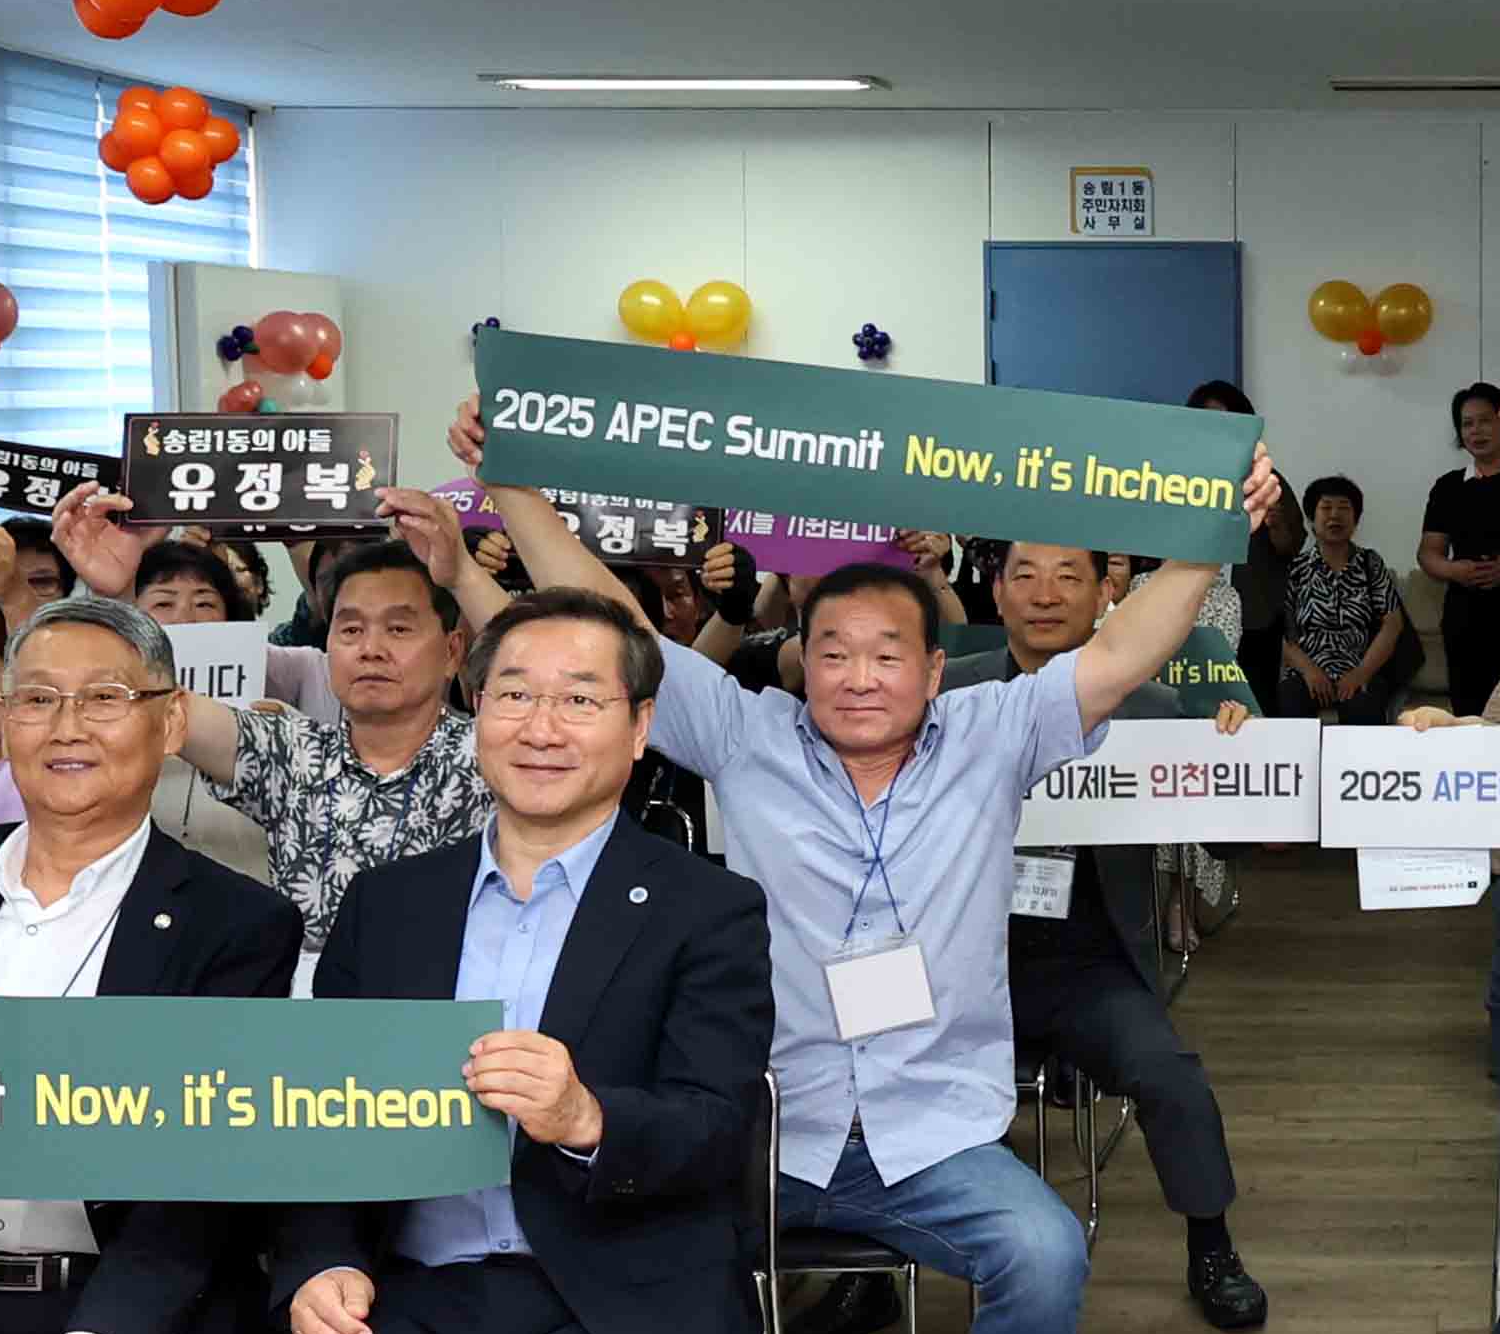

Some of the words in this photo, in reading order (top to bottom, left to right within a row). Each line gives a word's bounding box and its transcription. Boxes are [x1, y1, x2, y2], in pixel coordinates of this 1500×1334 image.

[1083, 198, 1145, 213] 주민자치회
[162, 429, 274, 456] 송림1동의
[282, 427, 332, 453] 아들
[493, 388, 595, 438] 2025
[605, 400, 712, 452] APEC
[725, 413, 884, 471] Summit
[905, 434, 1004, 491] Now,
[1016, 447, 1072, 493] it's
[1084, 453, 1235, 512] Incheon
[62, 460, 99, 478] 아들
[1168, 659, 1201, 685] it's
[1046, 765, 1138, 800] 이제는
[1150, 762, 1304, 799] 인천입니다
[1340, 770, 1422, 803] 2025
[34, 1074, 166, 1131] Now,
[182, 1070, 255, 1127] it's
[272, 1076, 471, 1128] Incheon
